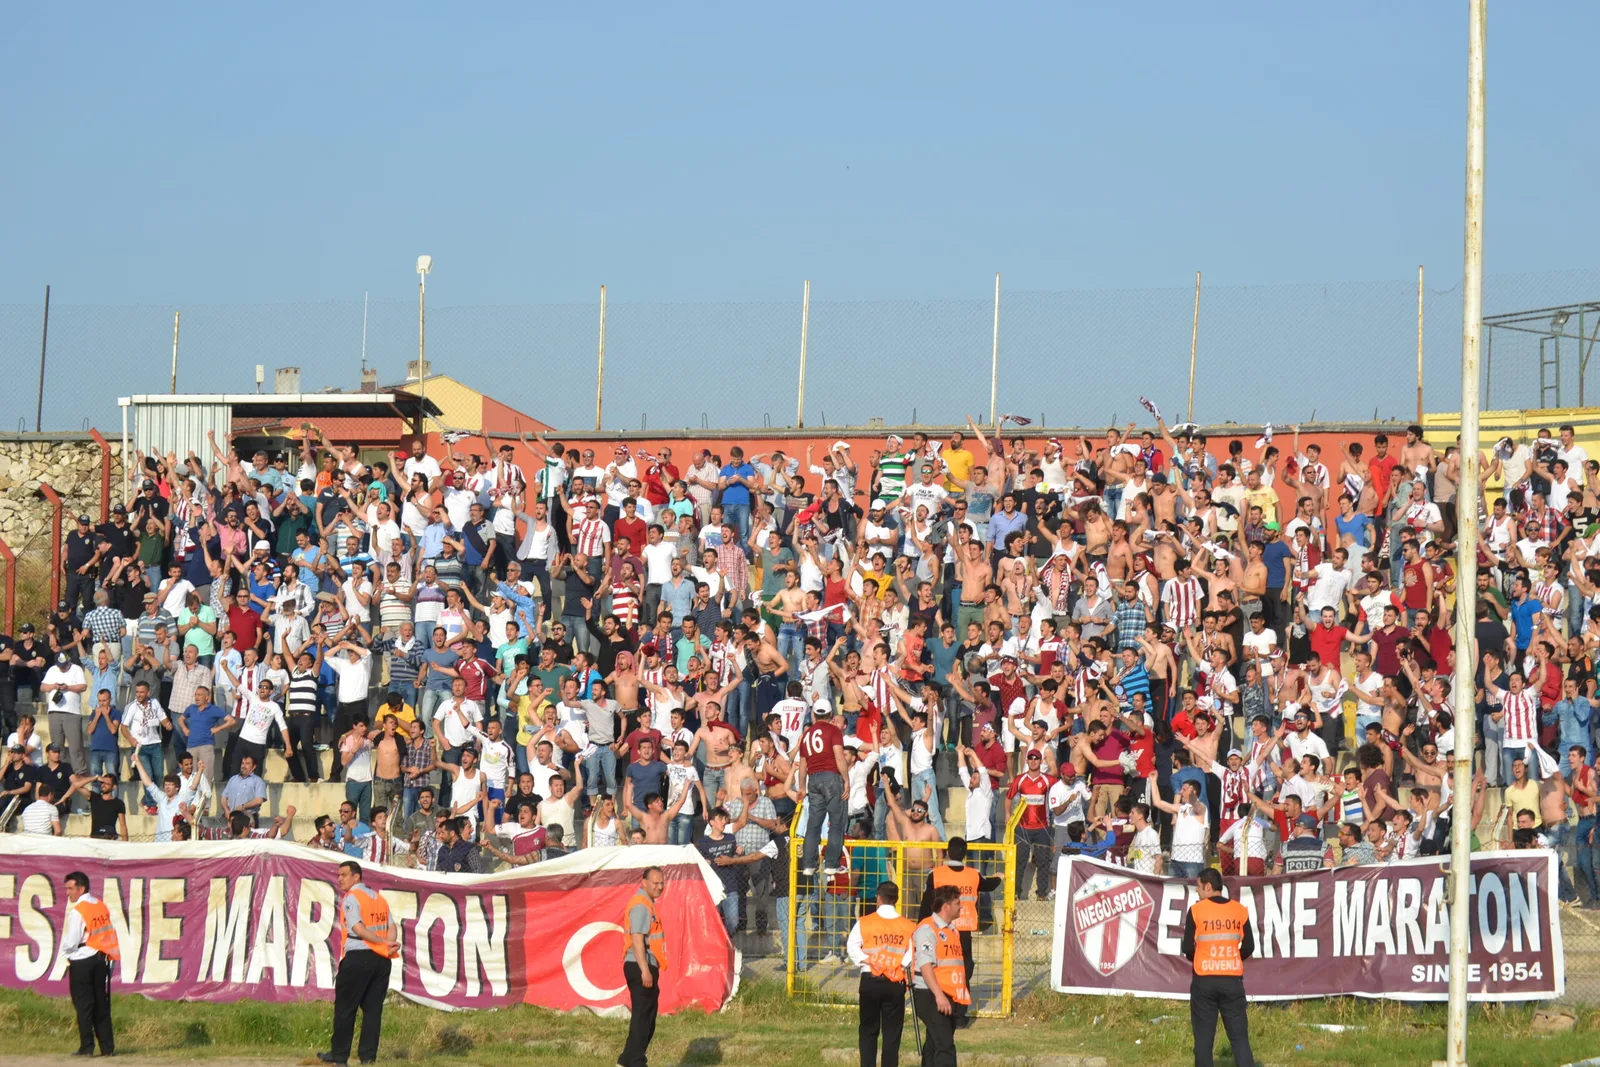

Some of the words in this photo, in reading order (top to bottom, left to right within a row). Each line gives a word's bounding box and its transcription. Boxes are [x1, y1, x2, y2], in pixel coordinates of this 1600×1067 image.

[1573, 517, 1588, 537] 5
[785, 712, 800, 732] 16
[803, 729, 824, 756] 16
[1076, 887, 1144, 930] İNEGÖLSPOR
[1332, 871, 1541, 957] MARAON
[1203, 918, 1240, 931] 719-014
[197, 874, 510, 998] MARTON
[873, 934, 904, 946] 719052
[1209, 945, 1238, 957] ÖZEL
[1100, 962, 1115, 970] 1954
[1411, 964, 1480, 983] SINE
[1488, 961, 1543, 981] 1954
